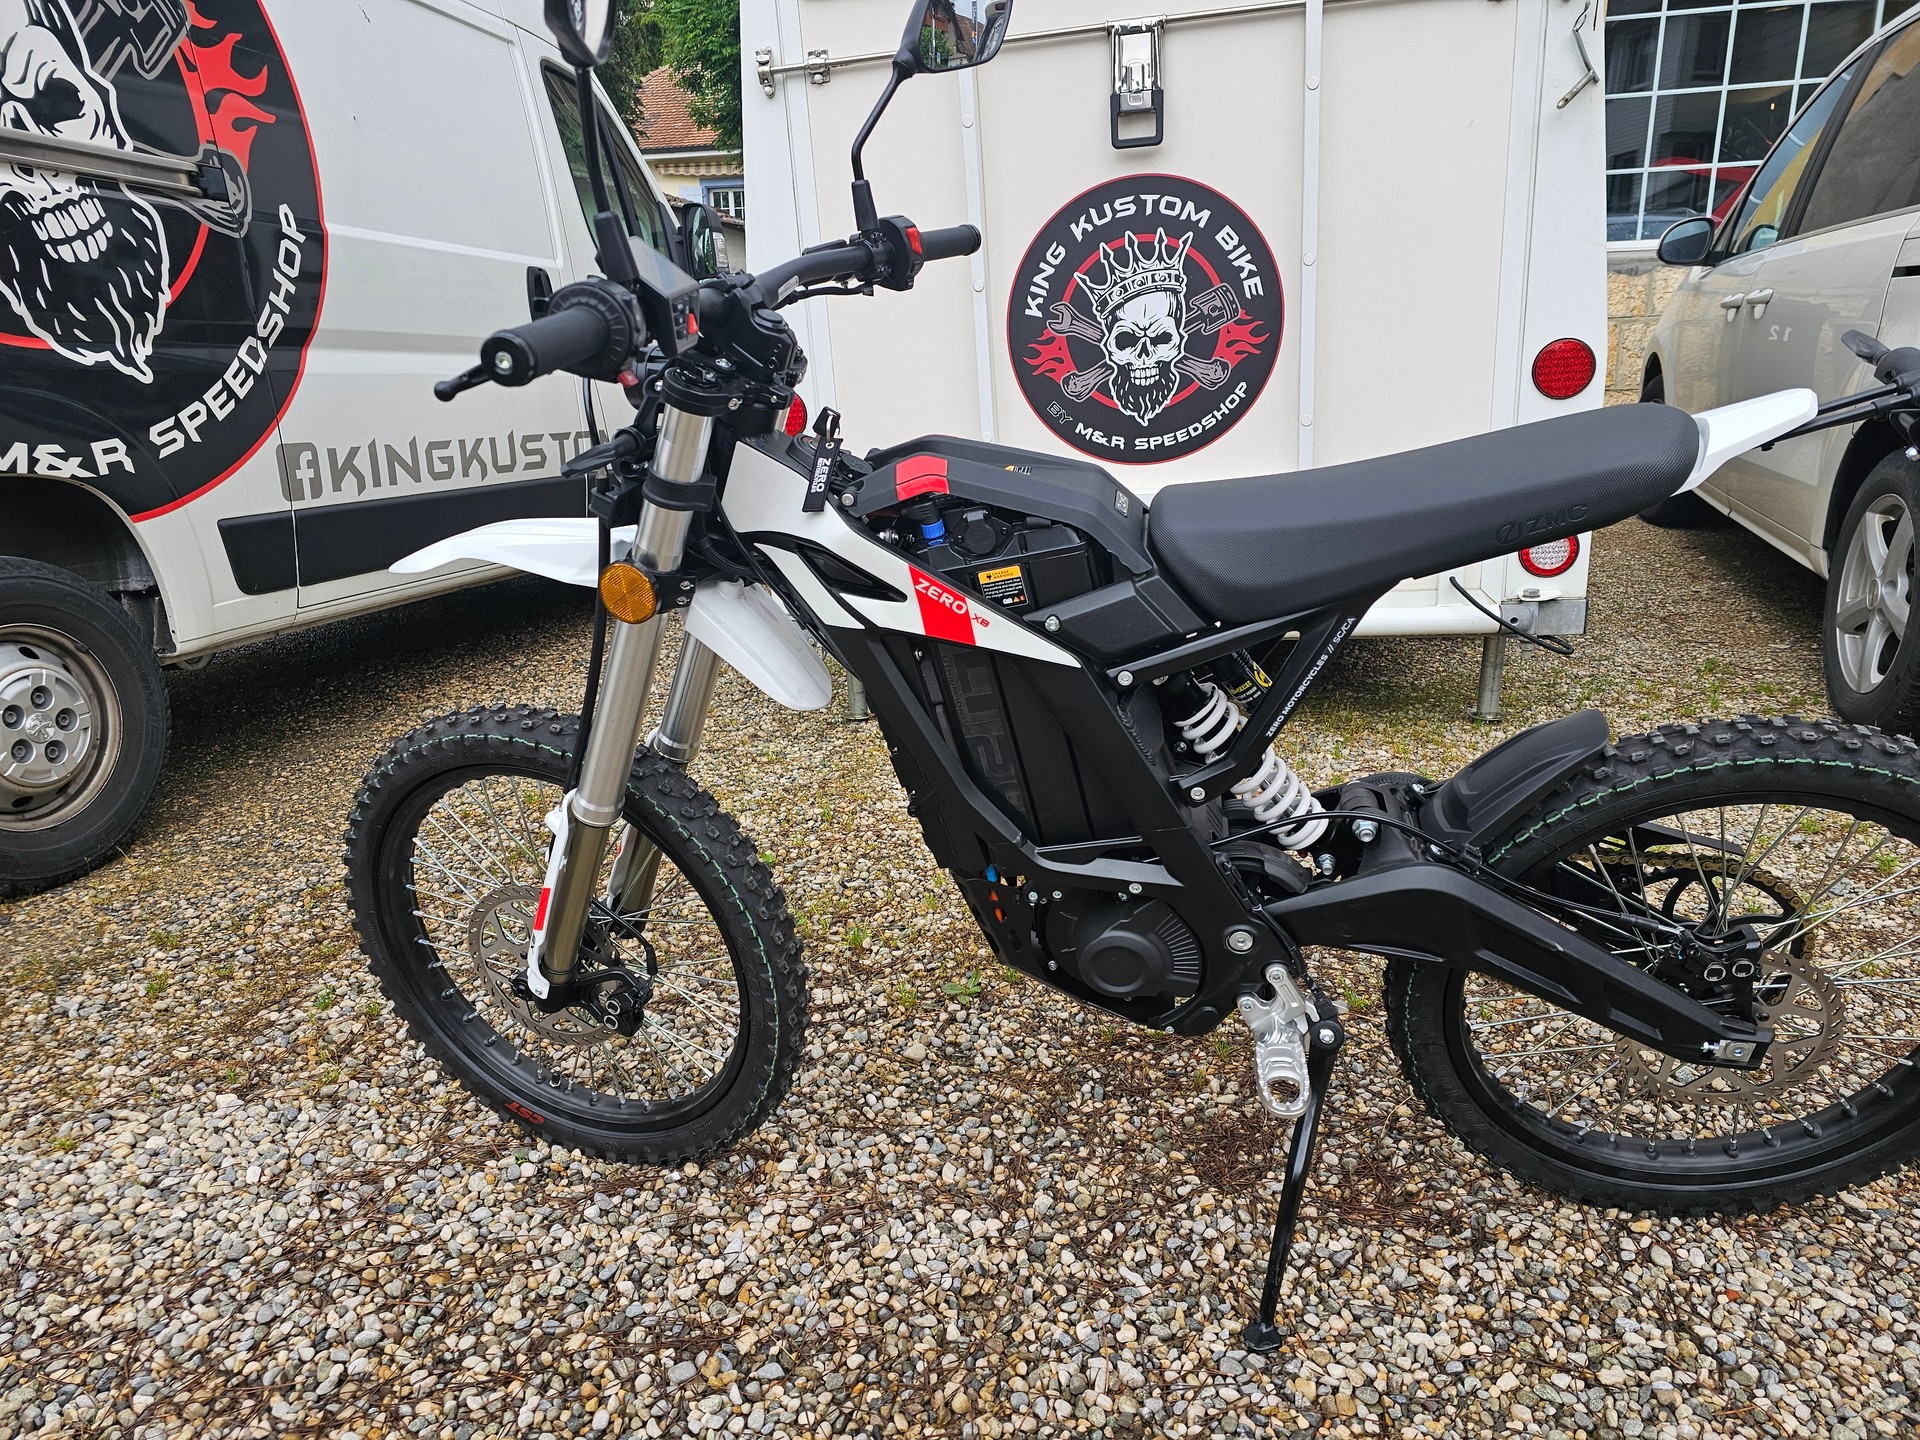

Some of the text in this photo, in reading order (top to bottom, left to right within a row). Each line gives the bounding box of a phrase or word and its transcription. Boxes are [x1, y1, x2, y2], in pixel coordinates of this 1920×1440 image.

[1025, 194, 1264, 318] KING KUSTOM BIKE
[149, 203, 306, 459] SPEEDSHOP
[1046, 381, 1247, 450] BY M&R SPEEDSHOP
[816, 457, 832, 492] ZERO
[914, 577, 990, 628] ZERO XB
[1265, 715, 1284, 738] ZERO
[1282, 654, 1328, 715] MOTORCYCLES
[1333, 617, 1357, 644] SC/CA
[504, 1101, 545, 1125] CST
